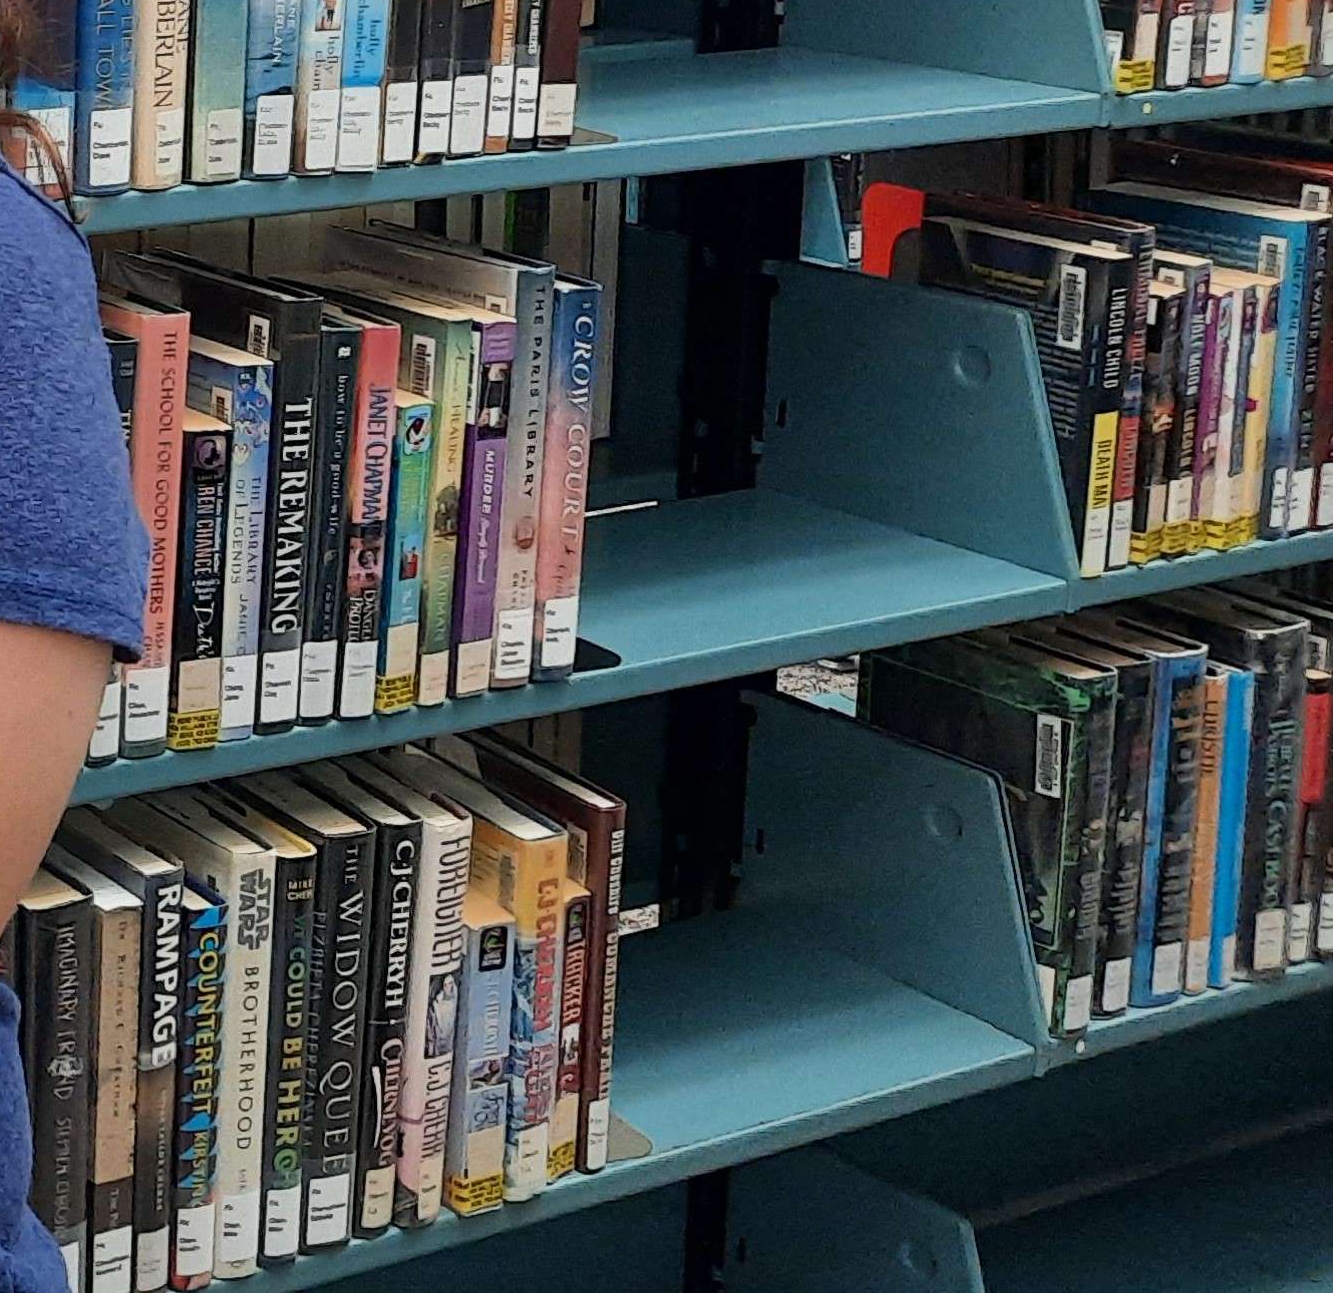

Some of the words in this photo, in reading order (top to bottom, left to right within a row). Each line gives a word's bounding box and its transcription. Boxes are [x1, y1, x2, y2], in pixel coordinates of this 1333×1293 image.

[161, 329, 178, 363] THE
[1106, 287, 1128, 345] LINCOLN
[157, 365, 178, 436] SCHOOL
[527, 336, 545, 400] PARIS
[567, 313, 597, 417] CROW
[155, 440, 175, 476] FOR
[281, 395, 316, 463] THE
[522, 407, 543, 500] LIBRARY
[151, 478, 175, 532] GOOD
[559, 422, 589, 548] COURT
[147, 537, 168, 615] MOTHERS
[269, 467, 310, 636] REMAKING
[149, 882, 184, 1069] RAMPAGE
[284, 946, 307, 1029] COULD
[329, 890, 367, 1049] WIDOW
[384, 882, 413, 1010] CHERRYH
[190, 930, 221, 1115] COUNTERFEIT
[236, 965, 262, 1151] BROTHERHOOD
[280, 1035, 304, 1071] BE
